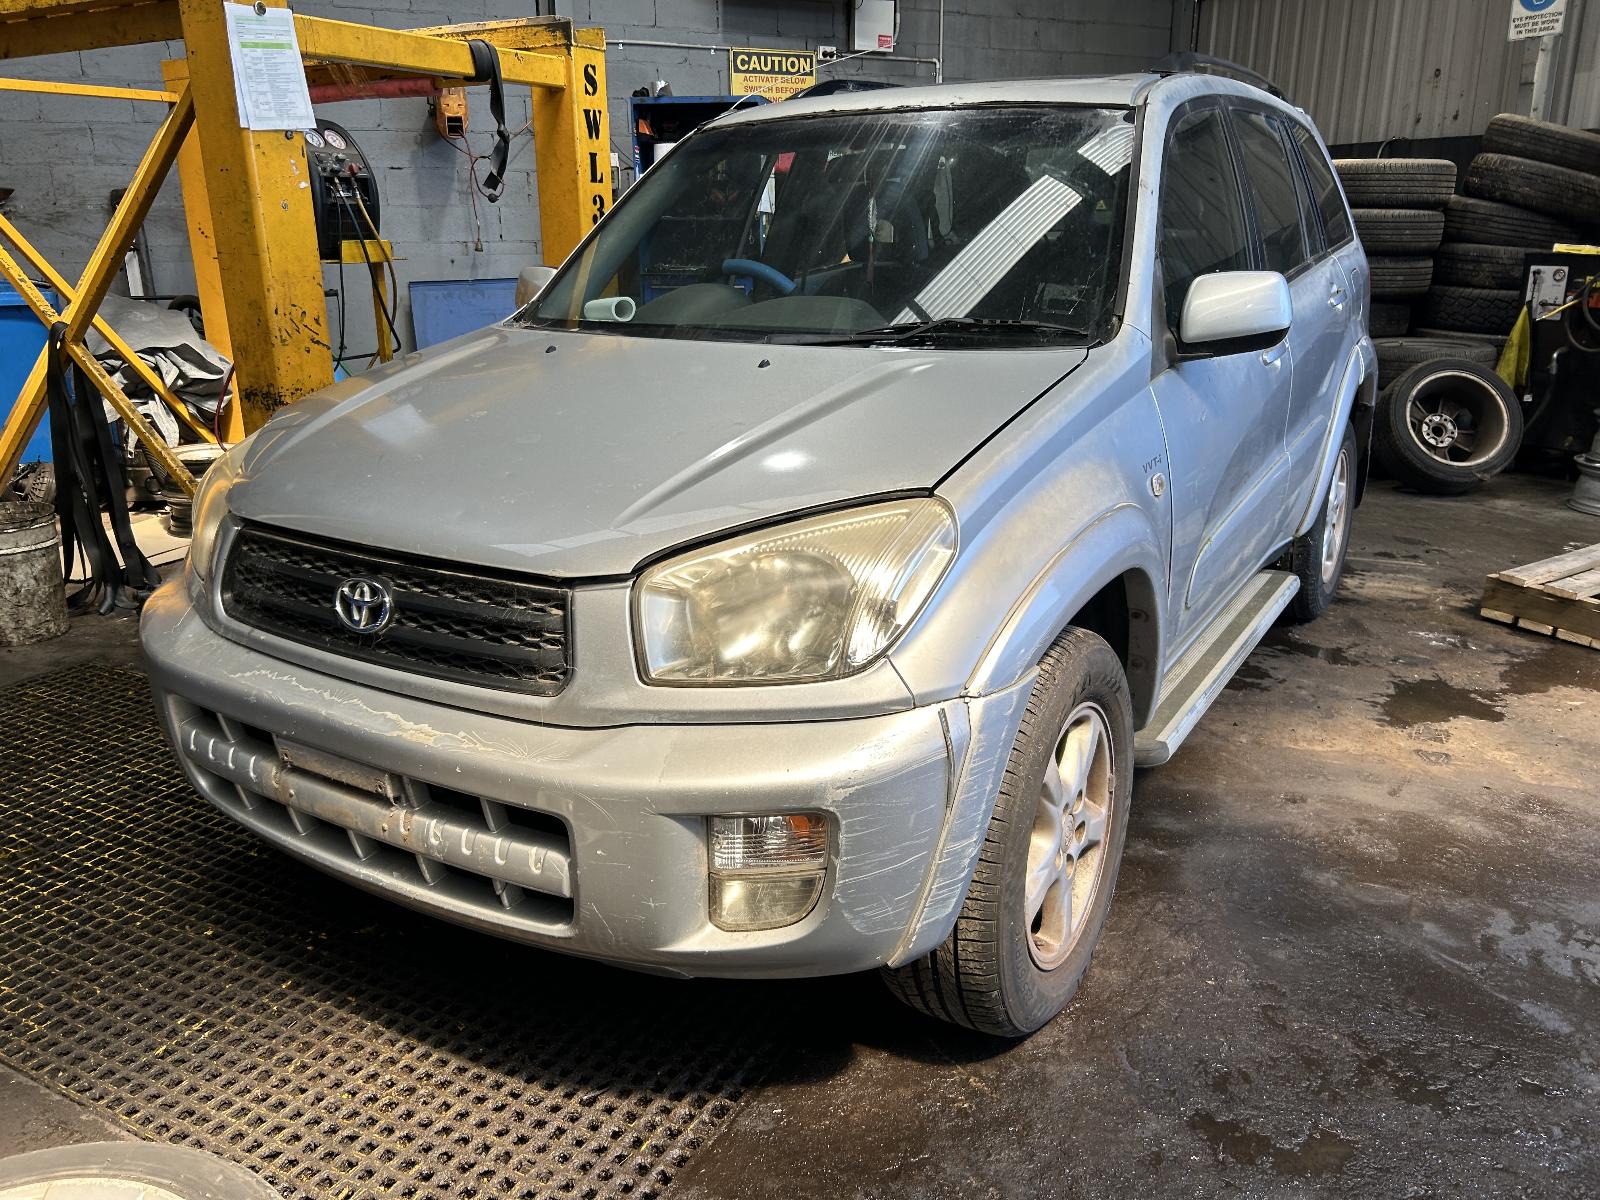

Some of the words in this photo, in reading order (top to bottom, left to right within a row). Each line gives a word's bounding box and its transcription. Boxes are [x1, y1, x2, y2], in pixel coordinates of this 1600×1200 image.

[1525, 11, 1563, 20] PROTECTION
[736, 54, 811, 73] CAUTION
[743, 75, 779, 84] ACTIVATE
[780, 76, 807, 85] BELOW
[744, 85, 773, 94] SWITCH
